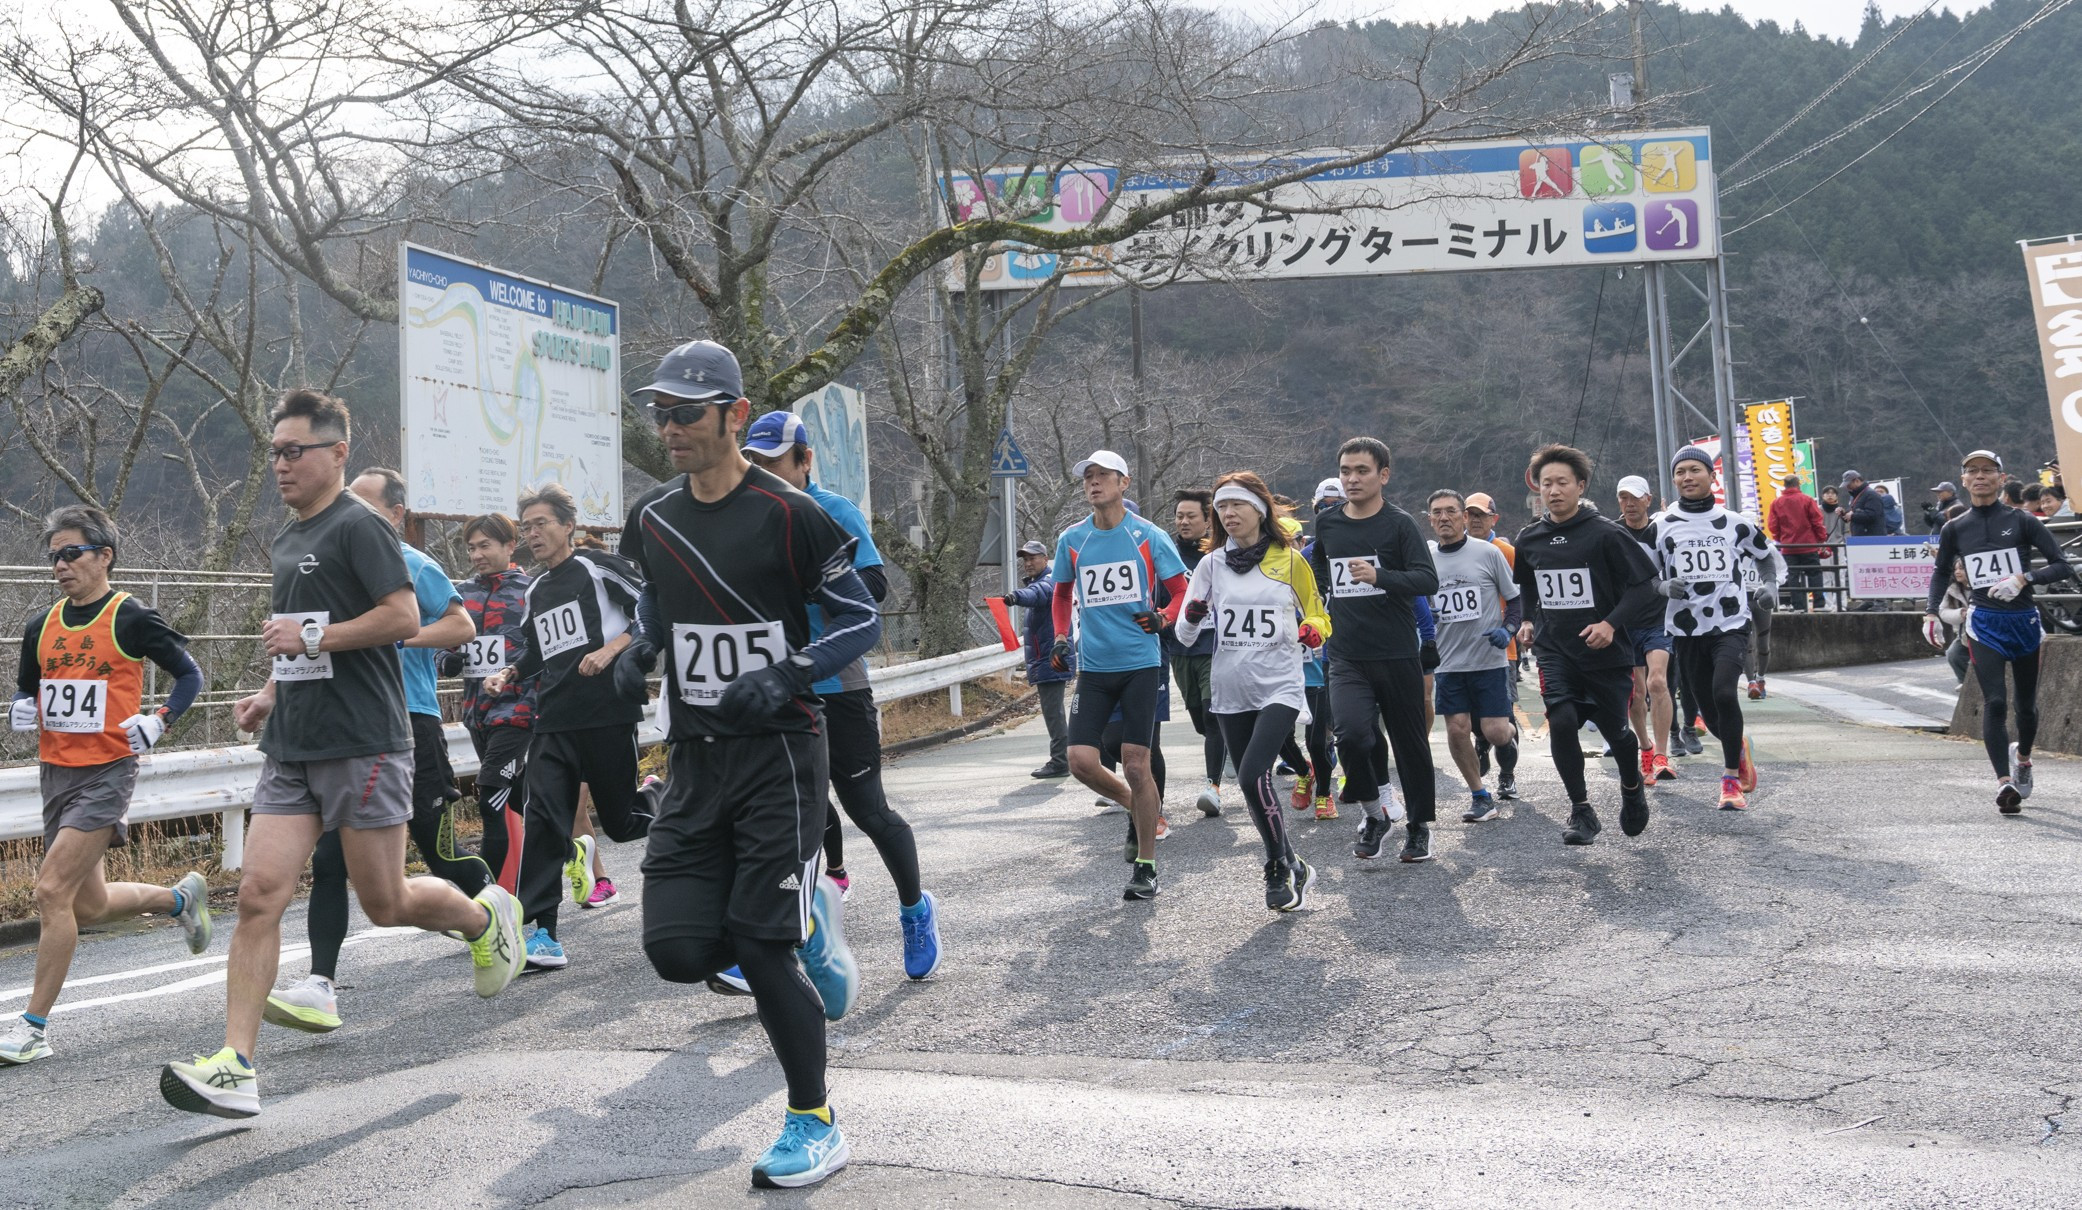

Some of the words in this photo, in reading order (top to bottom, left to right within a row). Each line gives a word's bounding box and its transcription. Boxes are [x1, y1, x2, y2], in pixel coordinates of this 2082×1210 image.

[408, 266, 448, 287] YACHIYO-CHO
[489, 279, 536, 311] WELCOME
[537, 294, 547, 314] to
[1681, 549, 1726, 573] 303
[1972, 552, 2014, 579] 241
[1085, 565, 1134, 596] 269
[1542, 572, 1584, 598] 319
[1439, 590, 1478, 615] 208
[540, 607, 577, 646] 310
[1223, 609, 1276, 638] 245
[684, 630, 774, 683] 205
[45, 684, 97, 718] 294
